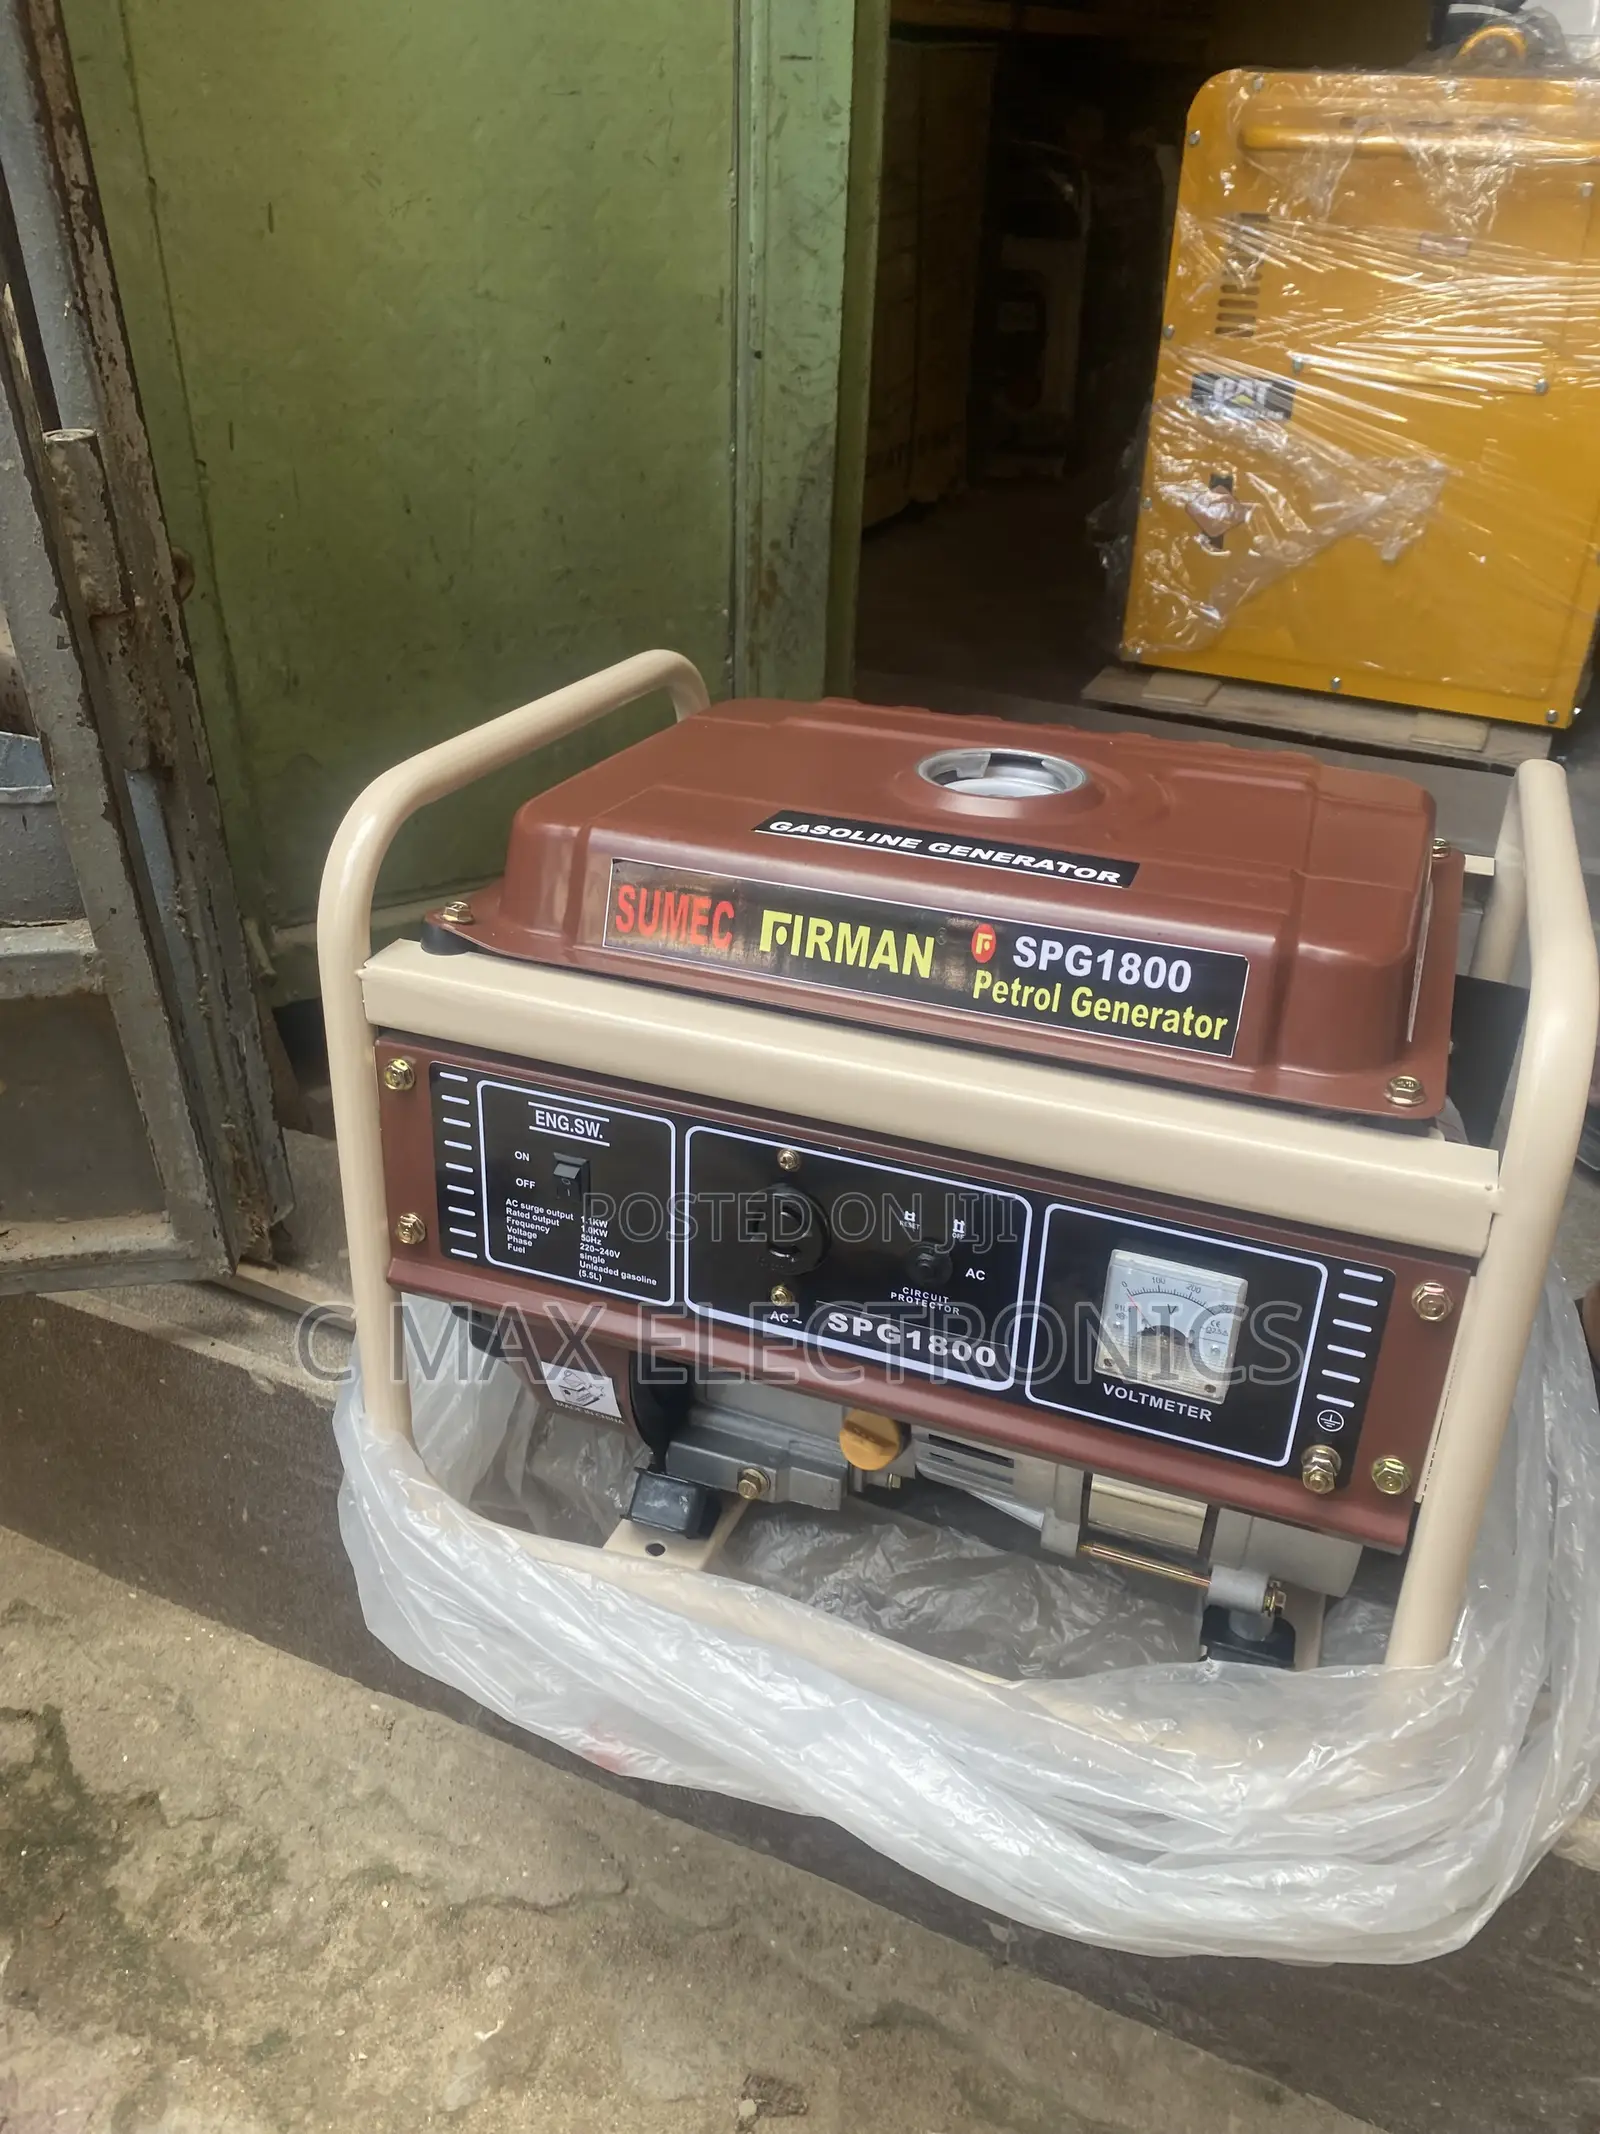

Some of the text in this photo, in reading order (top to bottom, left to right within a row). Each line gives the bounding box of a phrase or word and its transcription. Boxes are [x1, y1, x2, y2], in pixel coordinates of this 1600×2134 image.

[769, 820, 1122, 885] GASOLINE GENERATOR
[615, 884, 935, 979] SUMEC FIRMAN
[1013, 935, 1192, 993] SPG1800
[972, 969, 1229, 1041] Petrol Generator
[535, 1110, 604, 1139] ENG.SW.
[514, 1150, 530, 1162] ON
[515, 1177, 536, 1190] OFF
[505, 1198, 608, 1229] AC surge output 1.1KW
[506, 1207, 608, 1238] Rated output 1.0KW
[899, 1220, 921, 1231] RESET
[506, 1216, 602, 1246] Frequency 50Hz
[506, 1225, 538, 1239] Voltage
[952, 1231, 966, 1240] OFF
[507, 1233, 606, 1265] Phase single
[507, 1242, 658, 1286] Fuel Unleaded gasoline
[578, 1268, 603, 1283] (5.5L)
[965, 1267, 986, 1281] AC
[902, 1286, 950, 1304] CIRCUIT
[1185, 1283, 1202, 1294] 200
[890, 1291, 960, 1316] PROTECTOR
[827, 1311, 997, 1369] SPG1800
[1102, 1382, 1213, 1423] VOLTMETER
